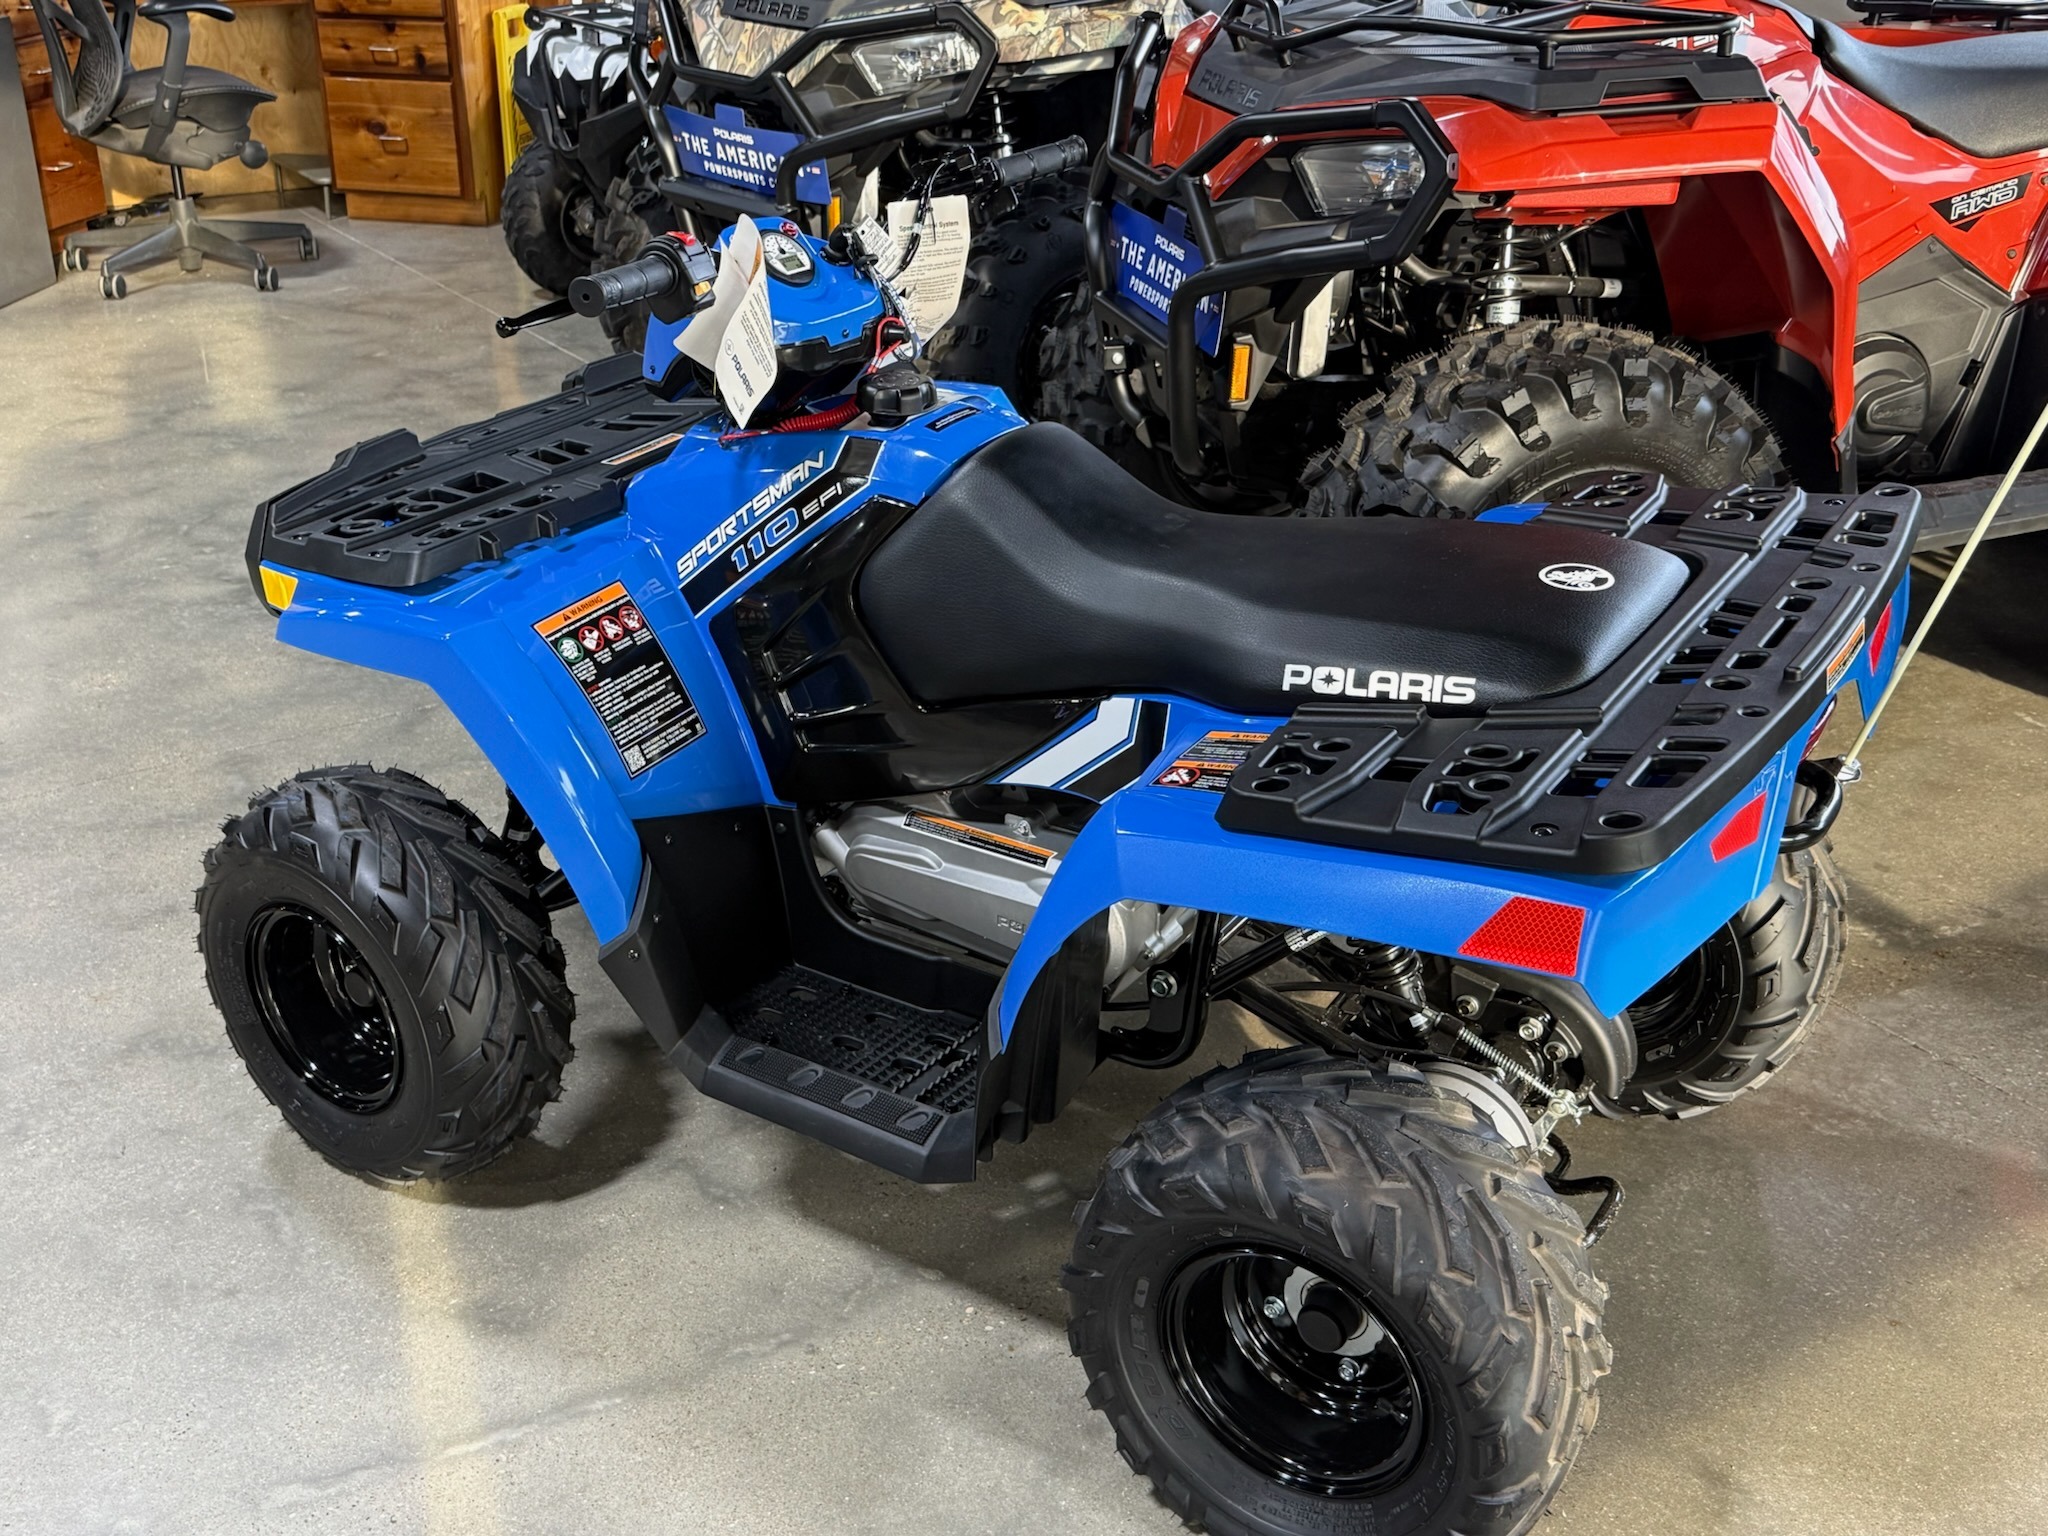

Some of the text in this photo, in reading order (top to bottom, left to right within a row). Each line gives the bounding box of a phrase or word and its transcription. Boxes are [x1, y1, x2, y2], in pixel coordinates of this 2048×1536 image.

[734, 0, 810, 21] POLARIS
[1199, 68, 1262, 108] POLARIS
[681, 132, 711, 157] THE
[712, 127, 754, 145] POLARIS
[704, 160, 766, 186] POWERSPORTS
[1950, 185, 2018, 220] AWD
[899, 224, 914, 233] Spee
[938, 220, 959, 229] System
[1120, 236, 1146, 271] THE
[1154, 234, 1185, 262] POLARIS
[731, 354, 754, 398] POLARIS
[676, 450, 825, 581] SPORTSMAN
[730, 481, 843, 573] 110 EFI
[569, 595, 604, 617] WARNING
[1281, 663, 1477, 705] POLARIS
